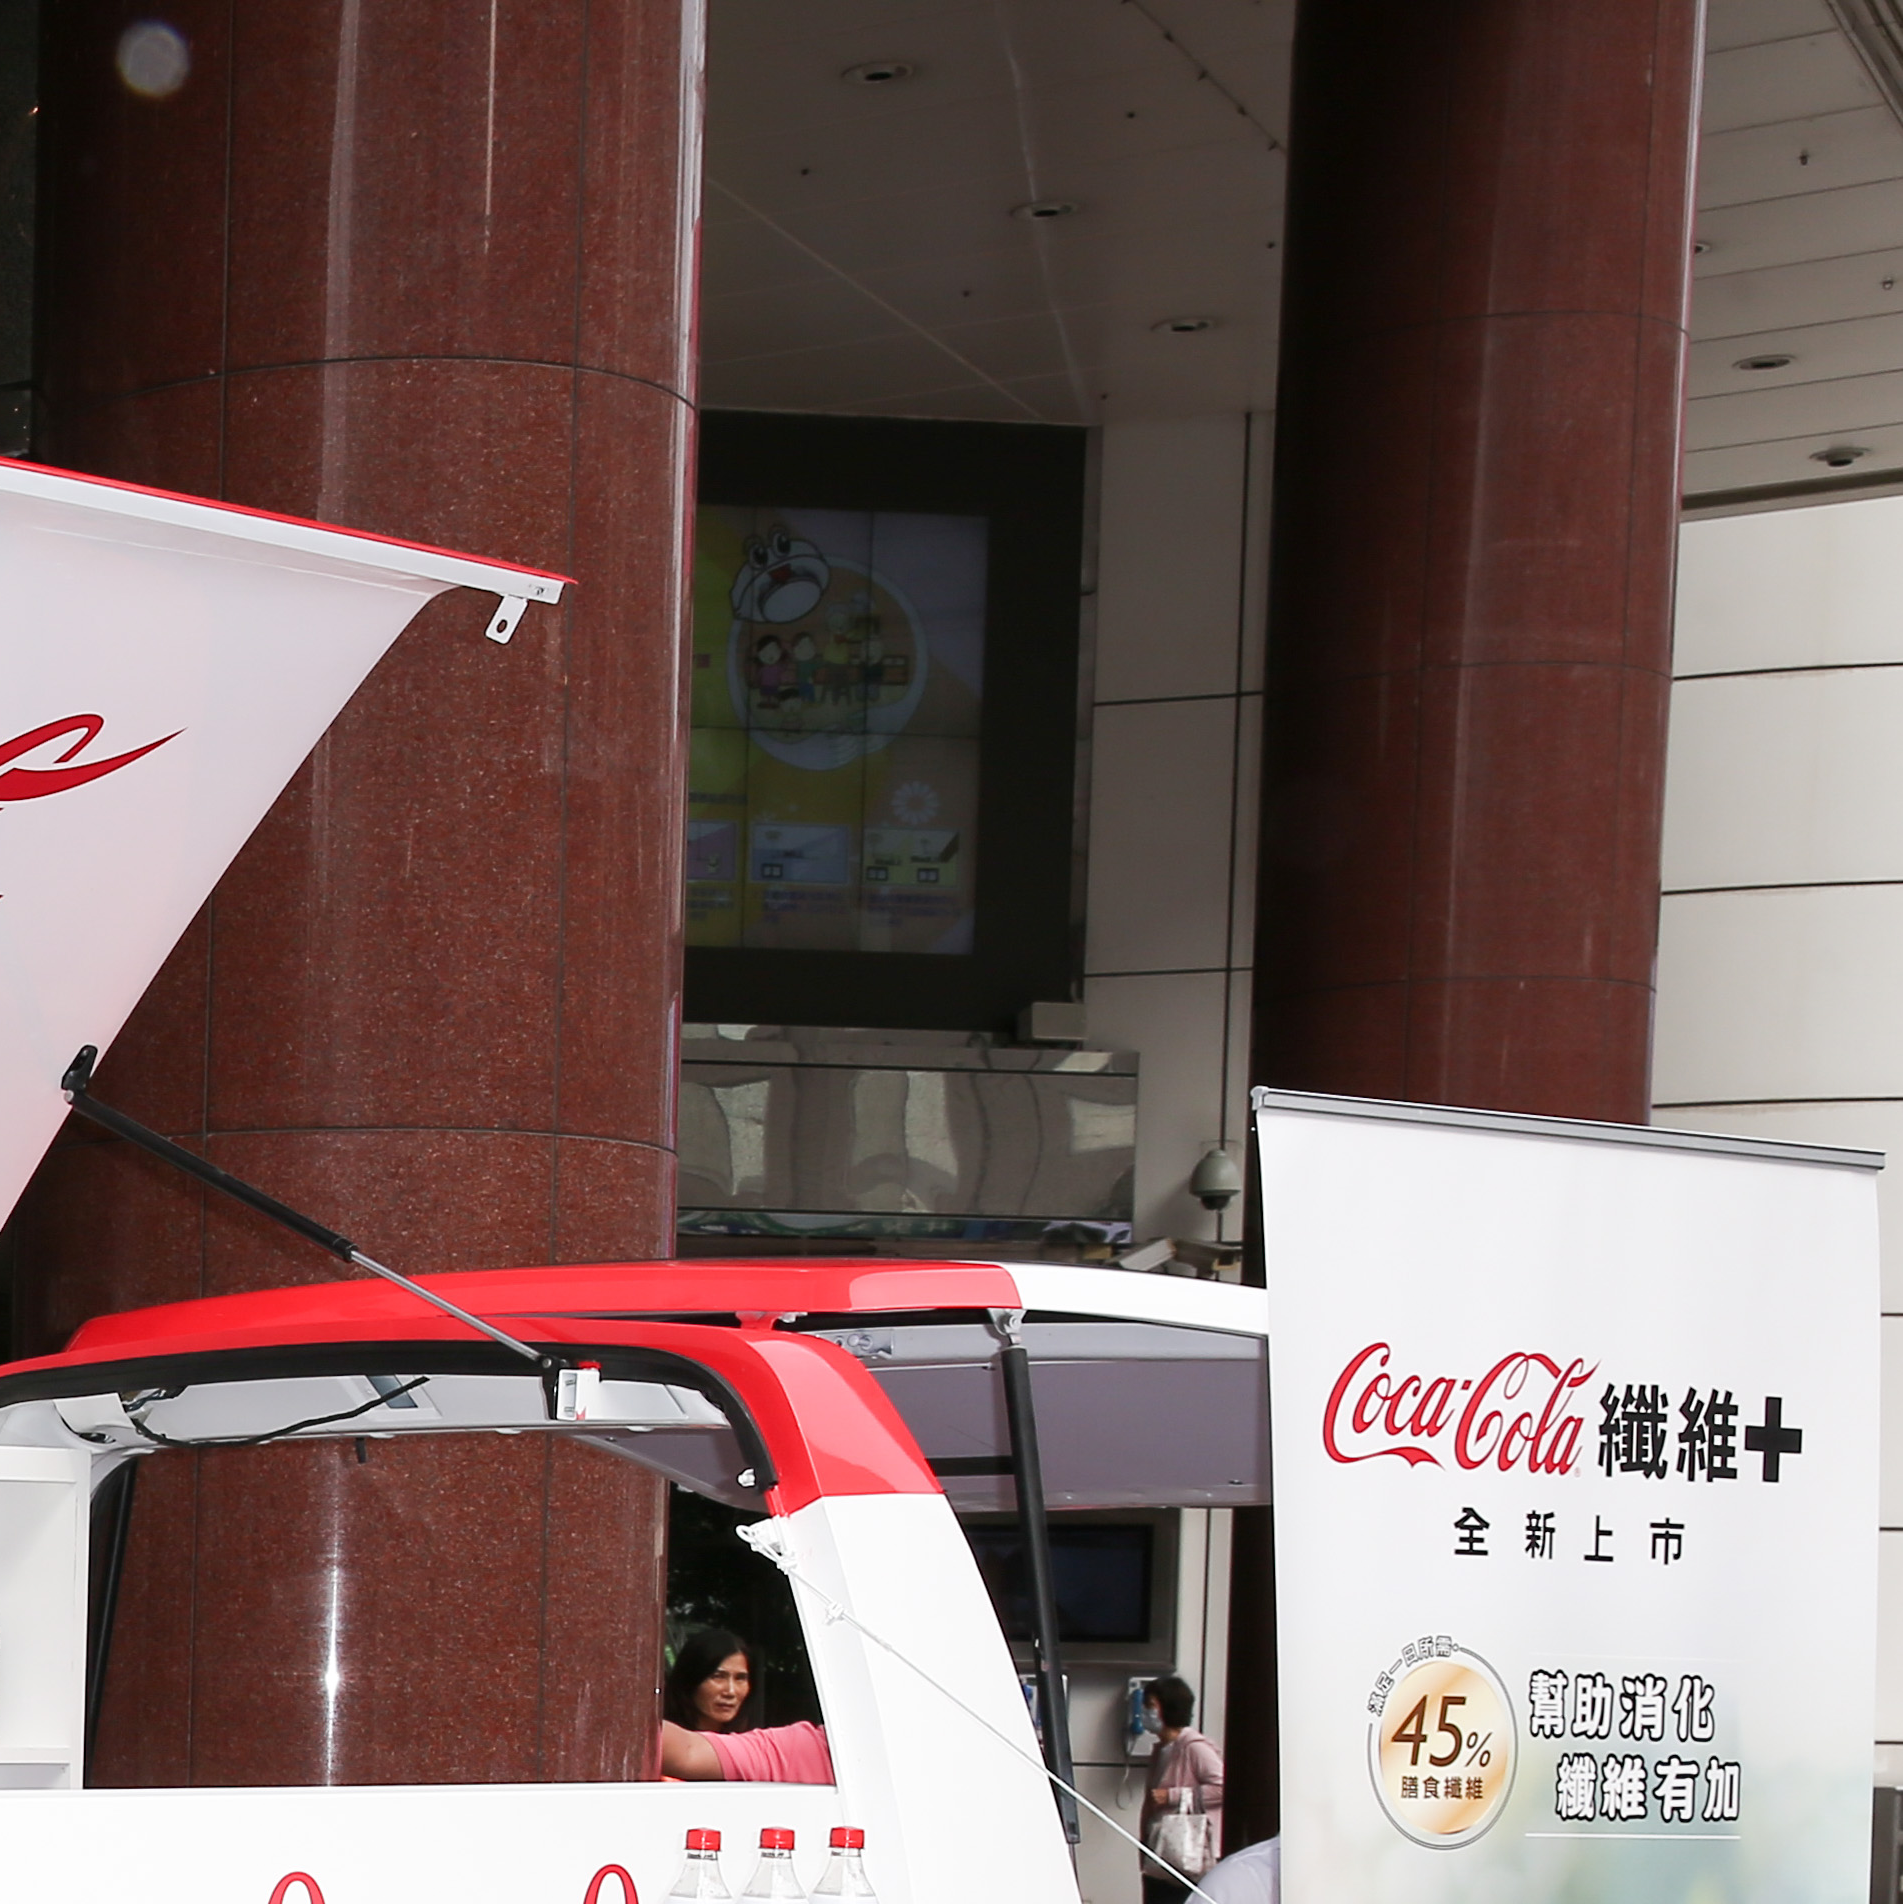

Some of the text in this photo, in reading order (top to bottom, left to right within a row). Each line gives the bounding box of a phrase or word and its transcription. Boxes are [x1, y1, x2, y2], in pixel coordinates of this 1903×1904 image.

[1323, 1342, 1601, 1477] Coca-Cola
[1391, 1694, 1492, 1767] 45%
[1528, 1670, 1715, 1743] 幫助消化
[1400, 1775, 1484, 1800] 膳食纖維
[1555, 1753, 1742, 1823] 纖維有加
